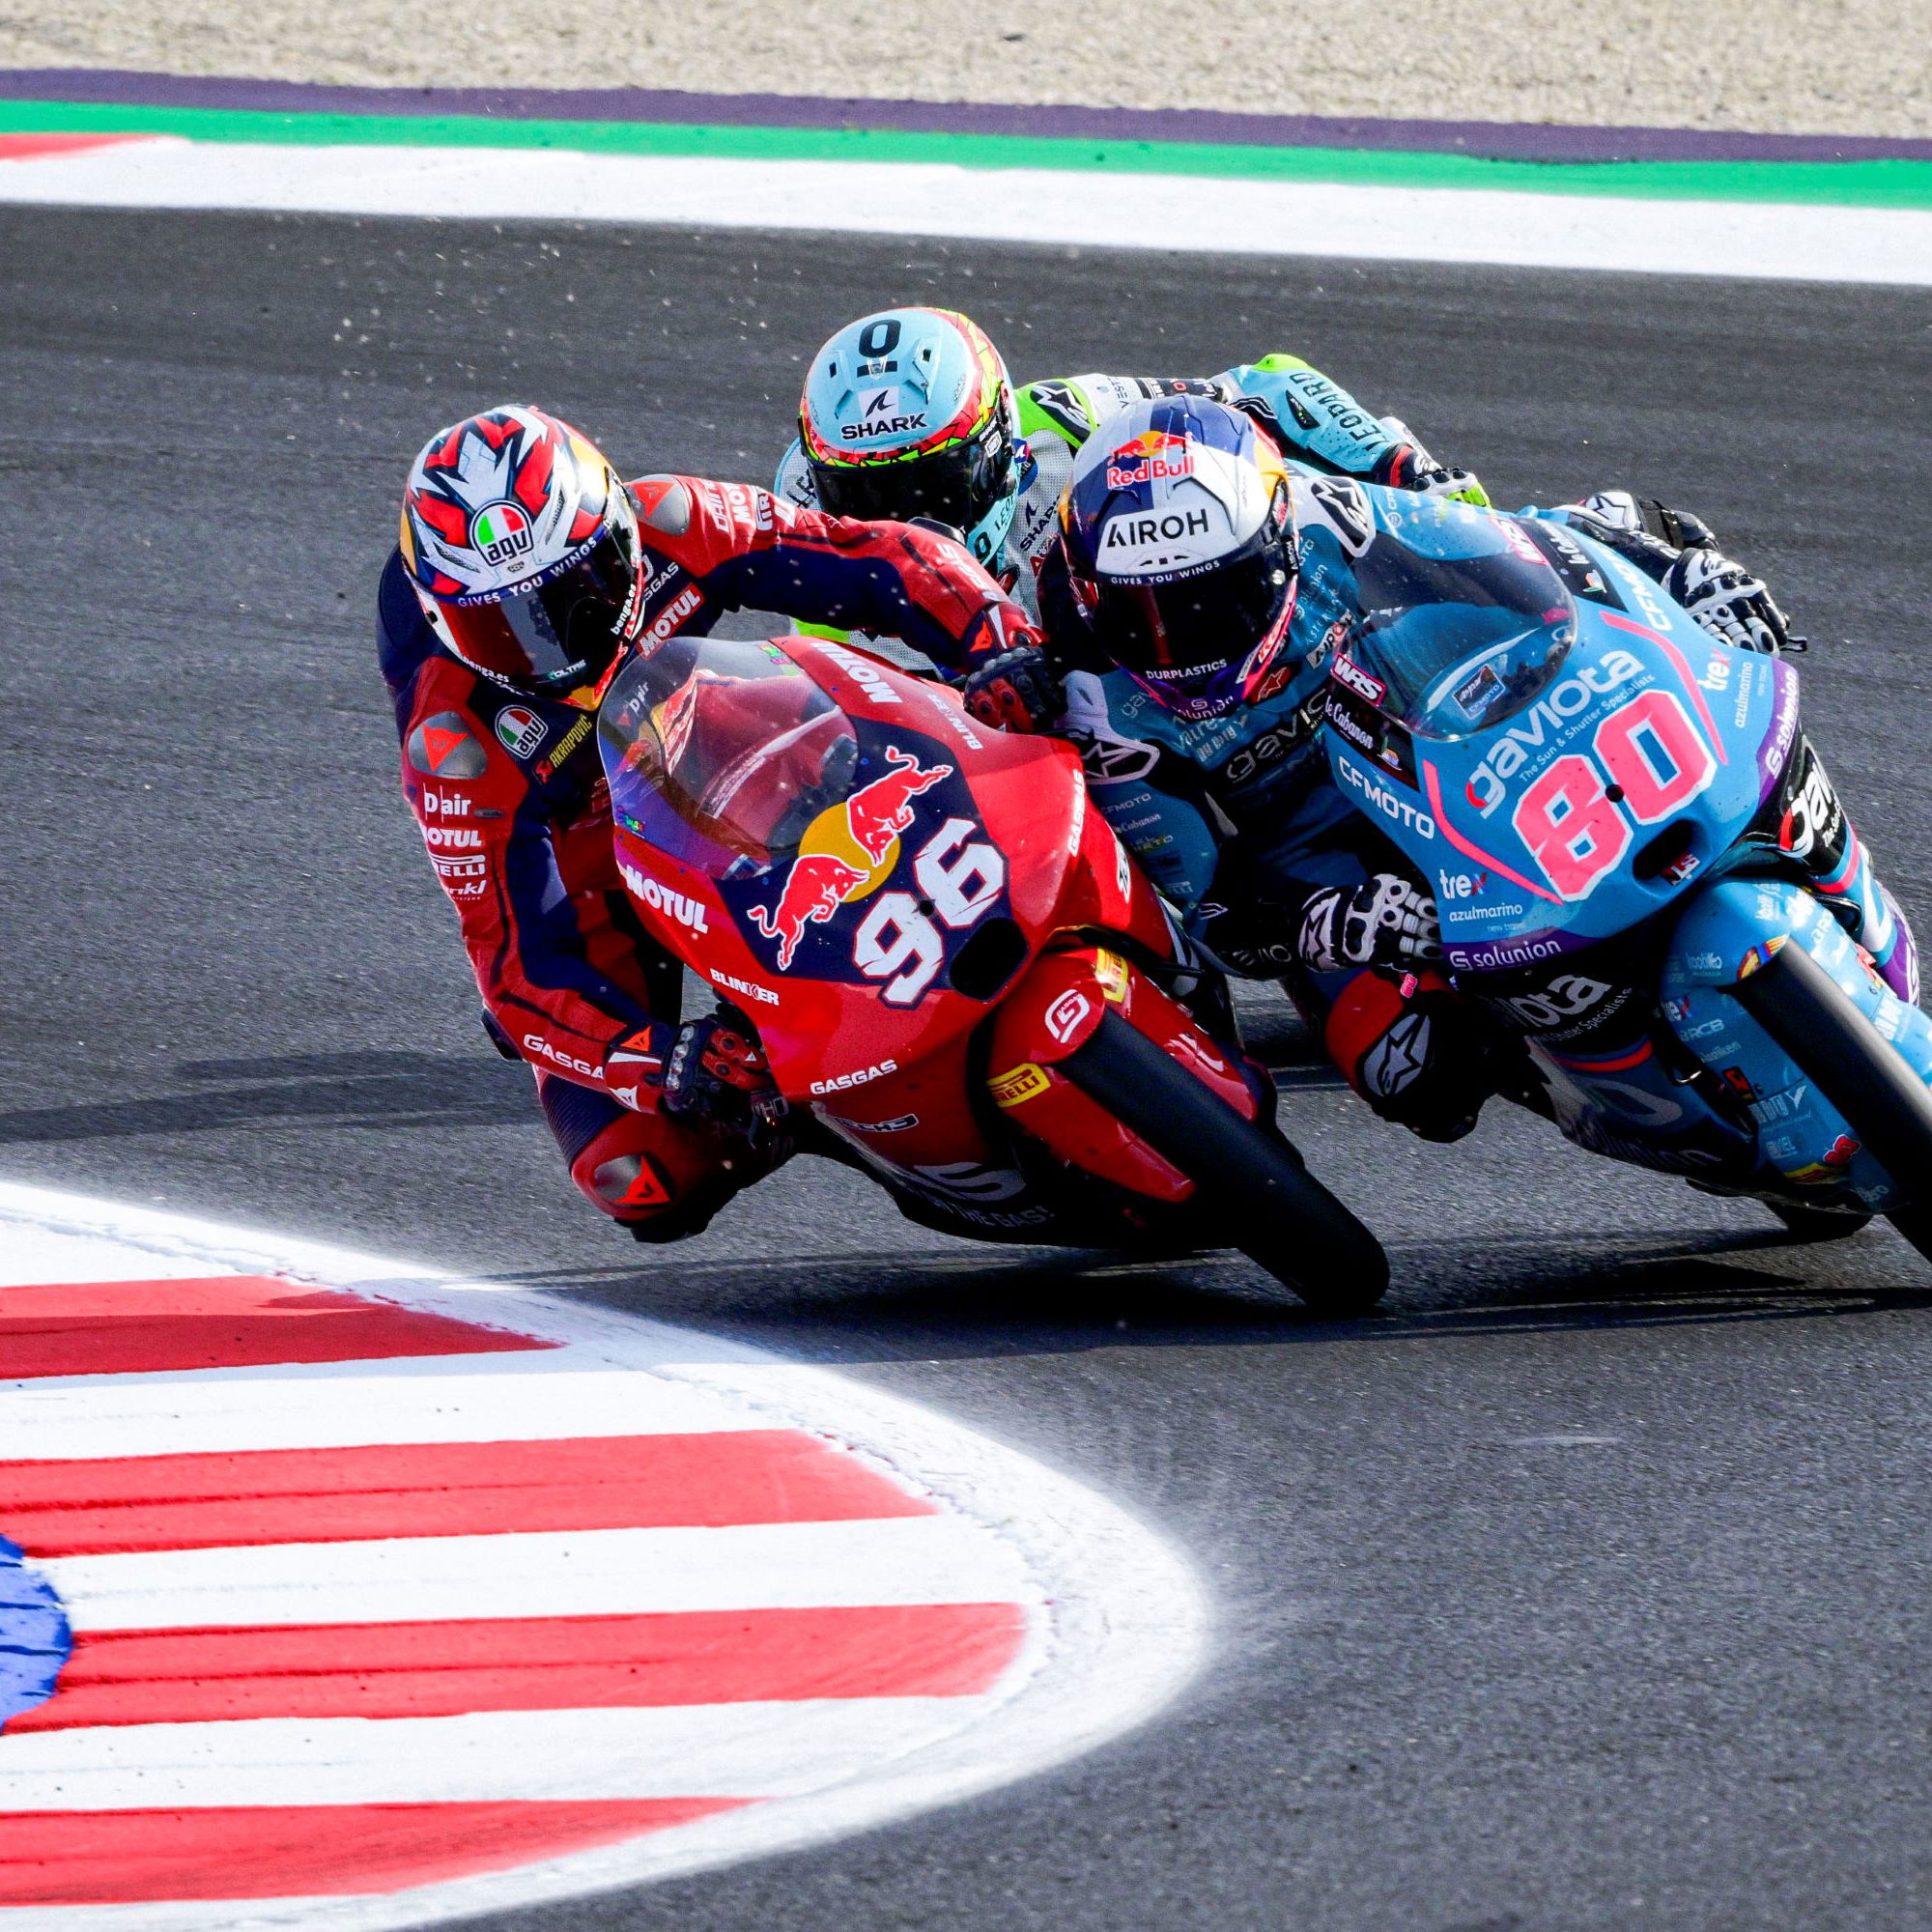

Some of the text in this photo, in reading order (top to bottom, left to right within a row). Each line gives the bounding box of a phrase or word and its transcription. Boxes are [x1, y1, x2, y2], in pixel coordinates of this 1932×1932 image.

[841, 413, 928, 440] SHARK
[1289, 372, 1392, 452] LEOPARD
[1107, 455, 1195, 490] Red Bull
[486, 531, 527, 561] agv
[1107, 508, 1208, 548] AIROH
[458, 537, 597, 608] GIVES YOU WINGS
[1111, 560, 1221, 585] GIVES YOU WINGS
[611, 583, 637, 636] benga.es
[639, 589, 701, 656] MOTUL
[1146, 659, 1227, 680] DURPLASTICS
[1735, 662, 1753, 728] azulmarino
[516, 721, 542, 754] agv
[1333, 702, 1374, 750] Cabanon
[1466, 649, 1645, 819] gaviota
[1519, 674, 1655, 782] The Sun & Shutter Specialists
[1339, 755, 1435, 839] CFMOTO
[1512, 690, 1718, 902] 80
[626, 865, 708, 934] MOTUL
[1439, 868, 1487, 899] trex
[852, 817, 1006, 1007] 96
[1450, 902, 1523, 923] azulmarino
[1473, 940, 1562, 967] solunion
[710, 968, 780, 1006] BLINKER
[1580, 987, 1634, 1030] Specialists
[810, 1060, 897, 1094] GASGAS
